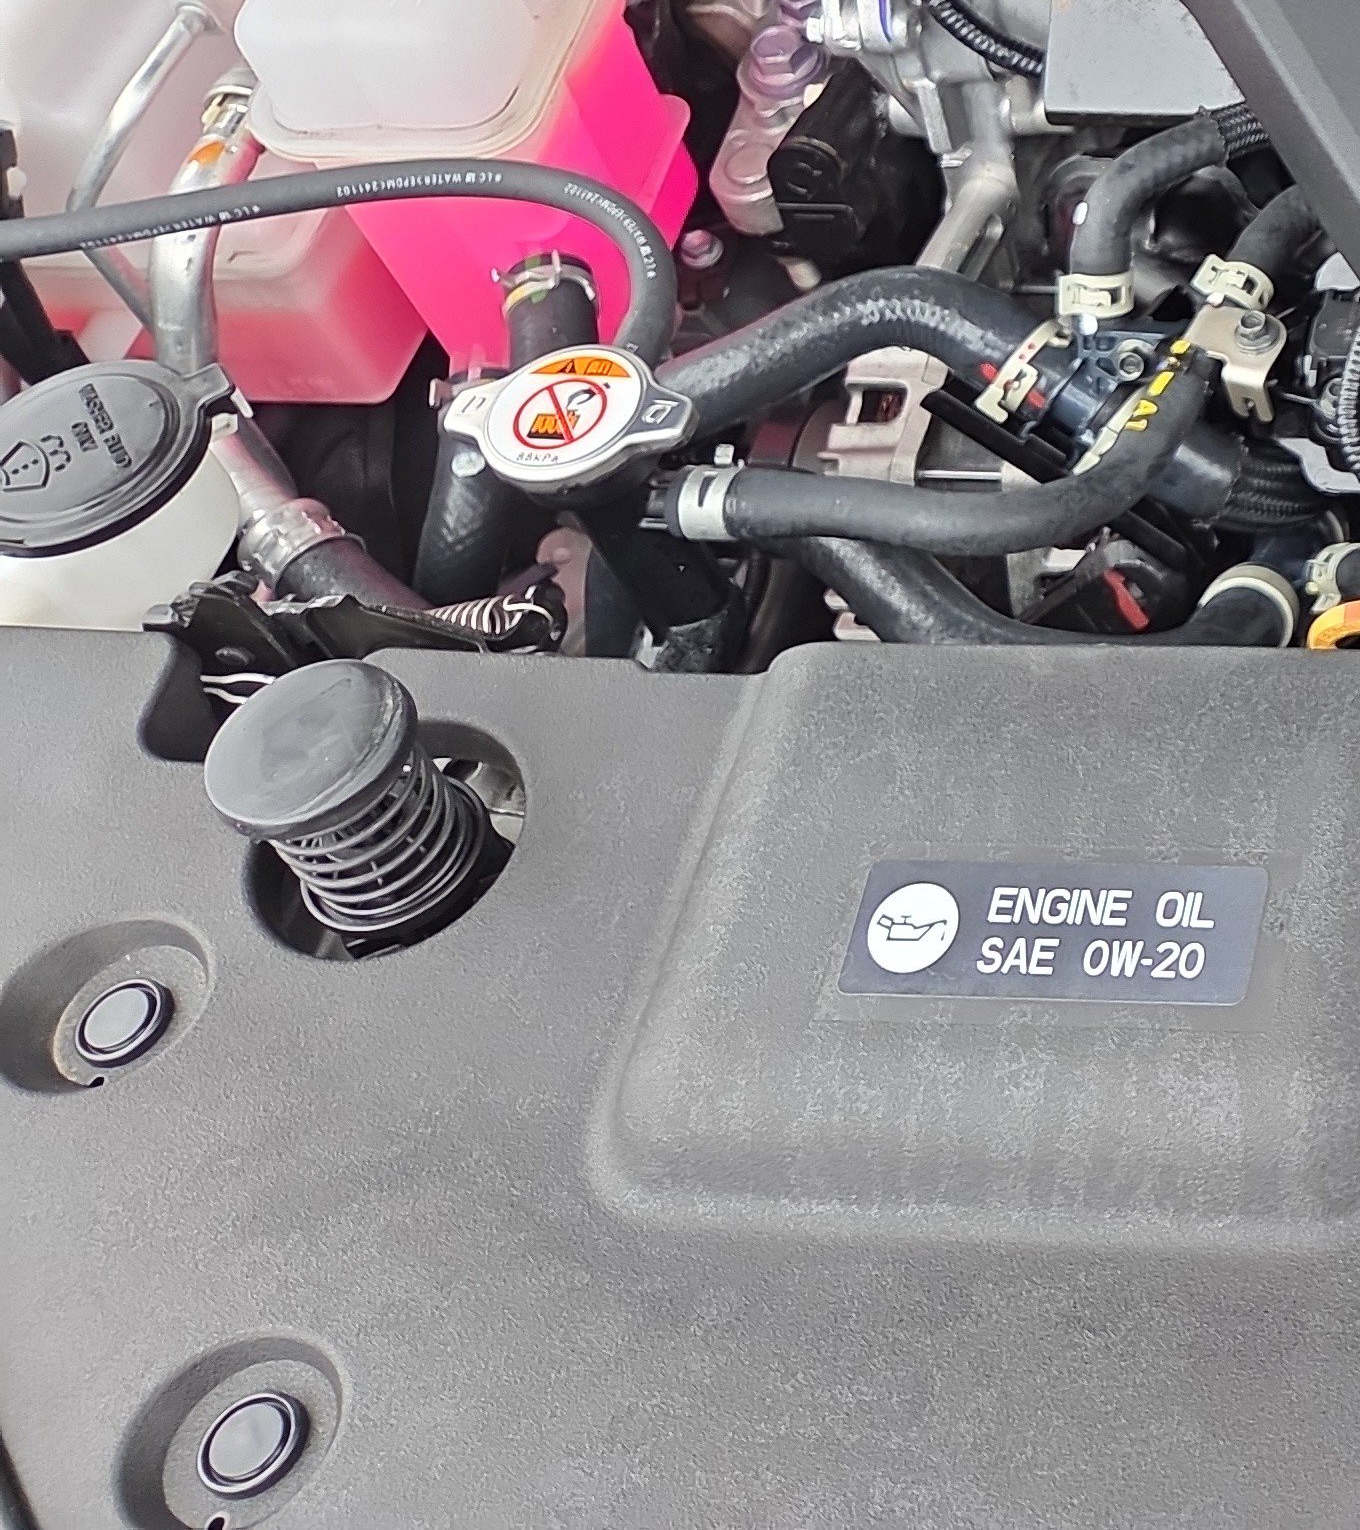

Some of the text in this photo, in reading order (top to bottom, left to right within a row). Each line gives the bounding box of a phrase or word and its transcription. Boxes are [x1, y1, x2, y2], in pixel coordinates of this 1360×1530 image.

[986, 886, 1215, 929] ENGINE OIL
[976, 936, 1206, 979] SAE 0W-20
